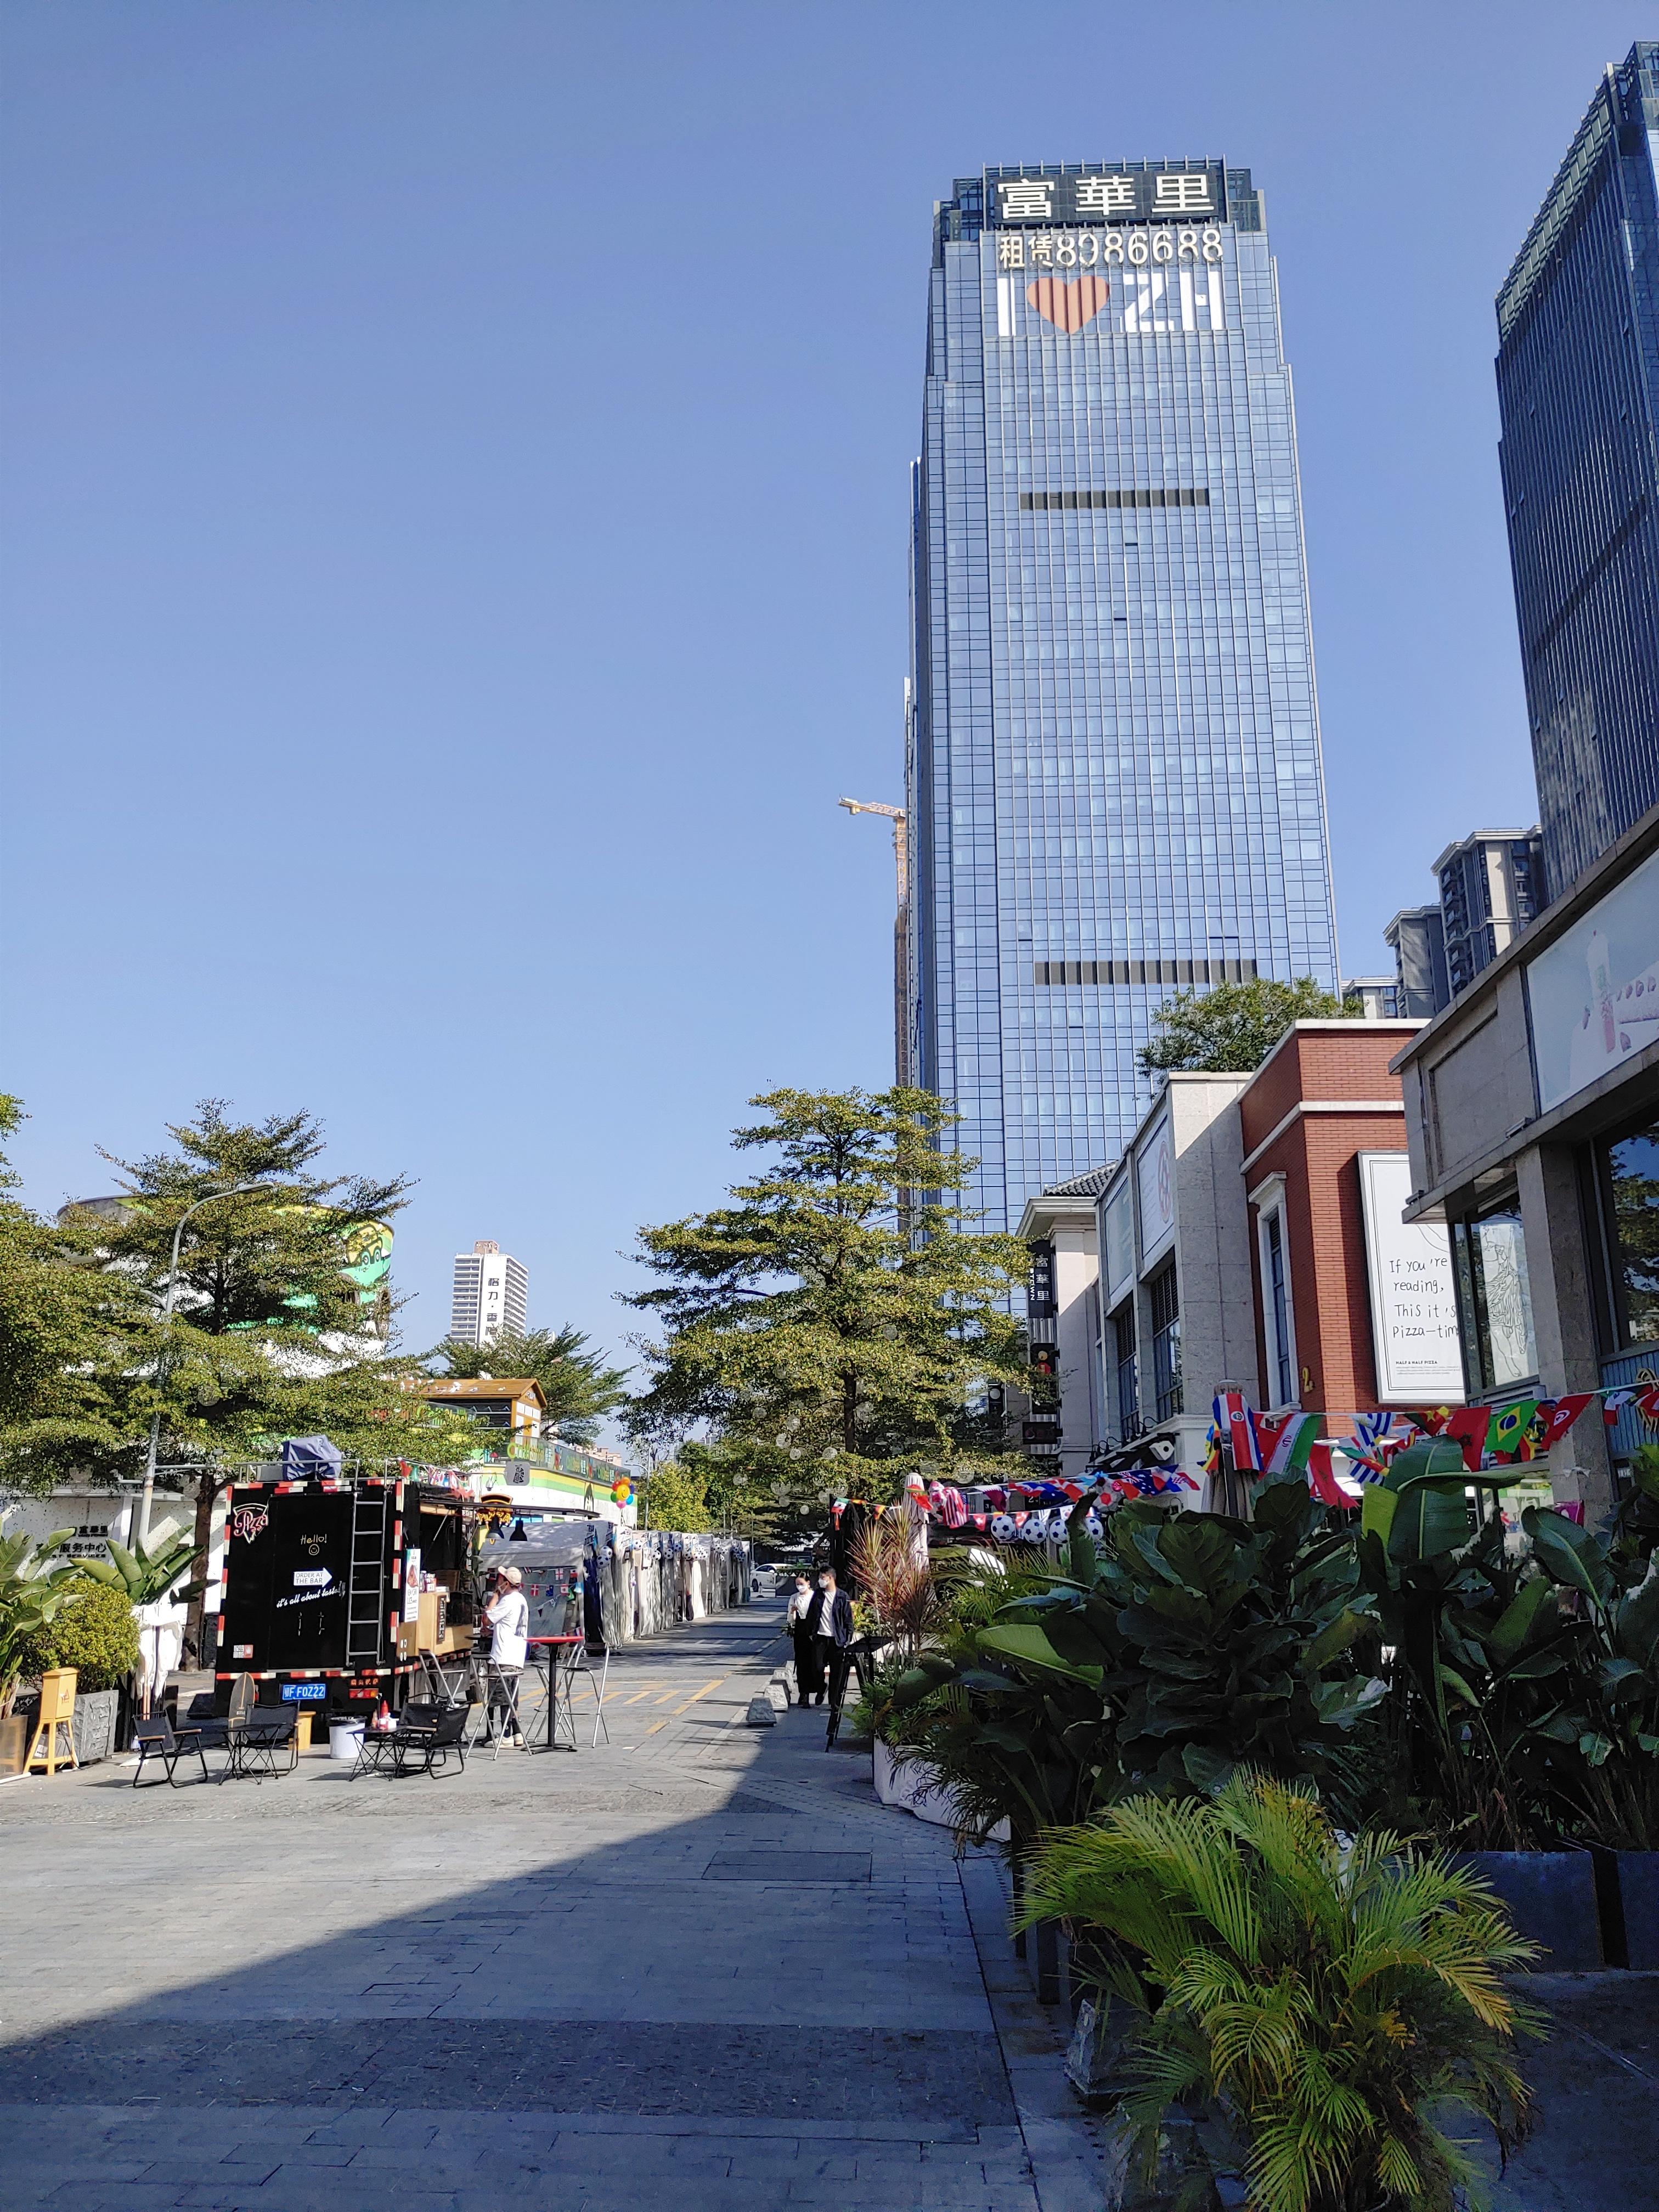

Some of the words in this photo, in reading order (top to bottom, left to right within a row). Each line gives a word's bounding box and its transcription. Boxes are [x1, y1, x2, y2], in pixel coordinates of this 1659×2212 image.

[997, 174, 1215, 219] 富華里
[997, 276, 1015, 336] I
[1120, 270, 1224, 332] ZH
[1389, 1259, 1401, 1273] If
[1393, 1280, 1444, 1294] reading,
[1394, 1304, 1421, 1317] This
[1393, 1324, 1460, 1339] Pizza-tim
[300, 1533, 327, 1545] Hello!
[290, 1593, 300, 1605] all
[301, 1590, 320, 1602] about
